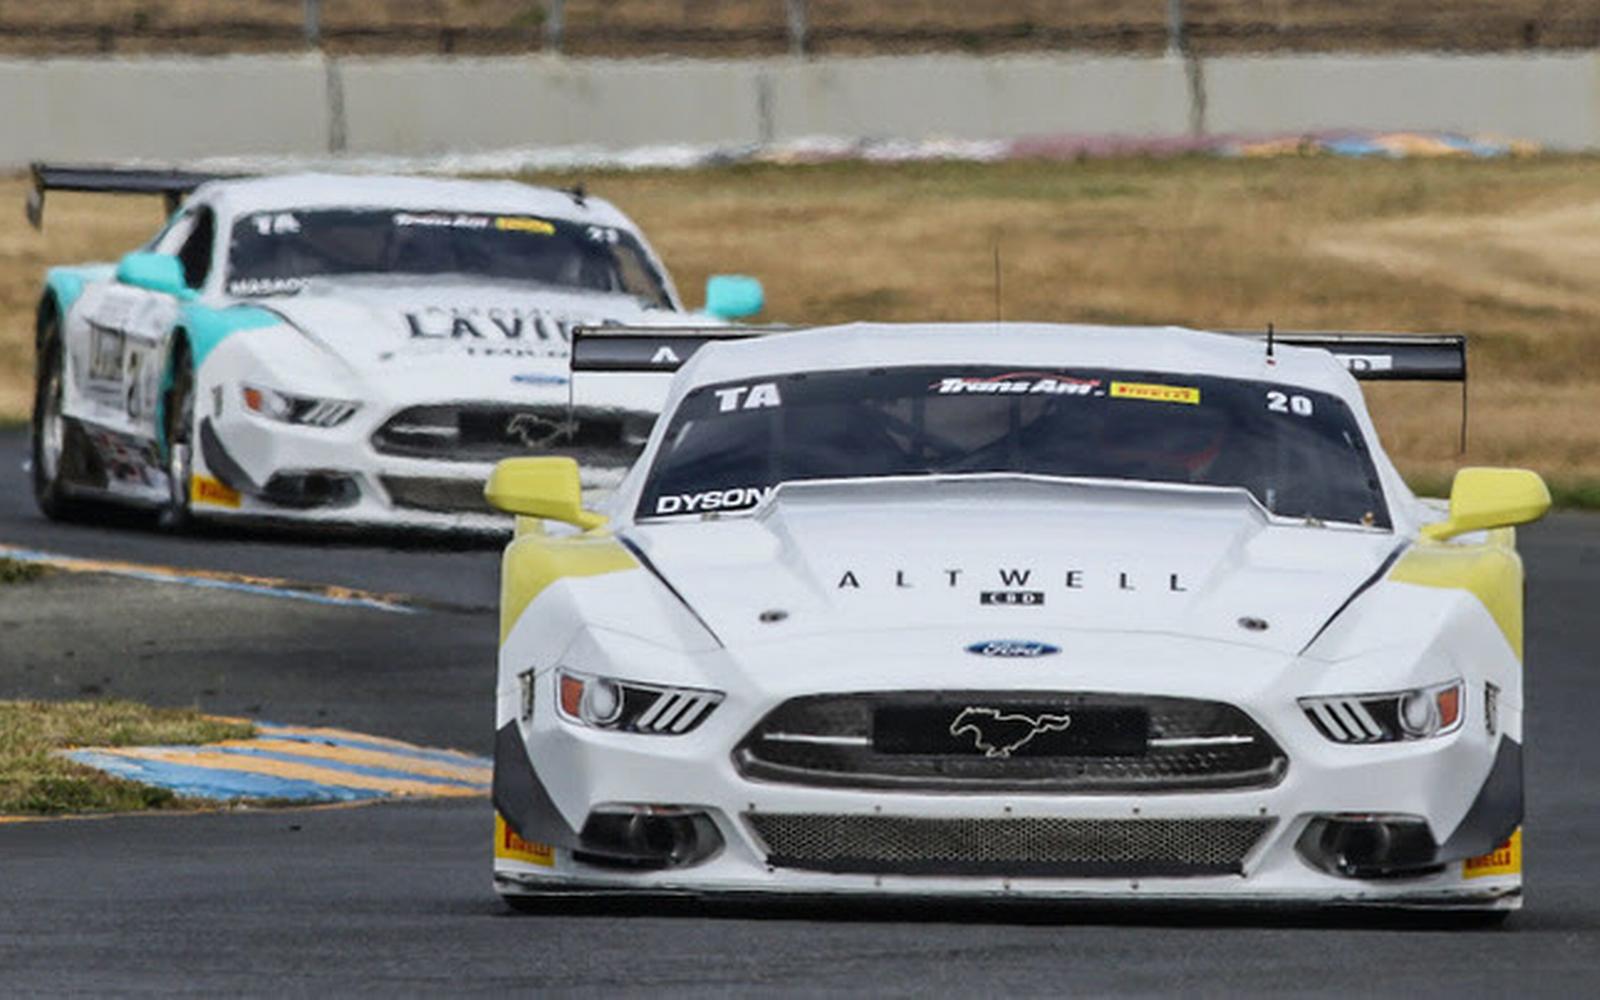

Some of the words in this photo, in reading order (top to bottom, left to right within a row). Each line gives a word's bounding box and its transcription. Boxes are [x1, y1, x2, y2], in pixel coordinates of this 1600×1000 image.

[252, 213, 300, 235] TA
[938, 377, 1030, 395] Trans
[714, 382, 782, 413] TA
[1266, 391, 1314, 417] 20
[655, 487, 773, 514] DYSON
[989, 592, 1037, 605] CBD
[982, 641, 1044, 658] Ford
